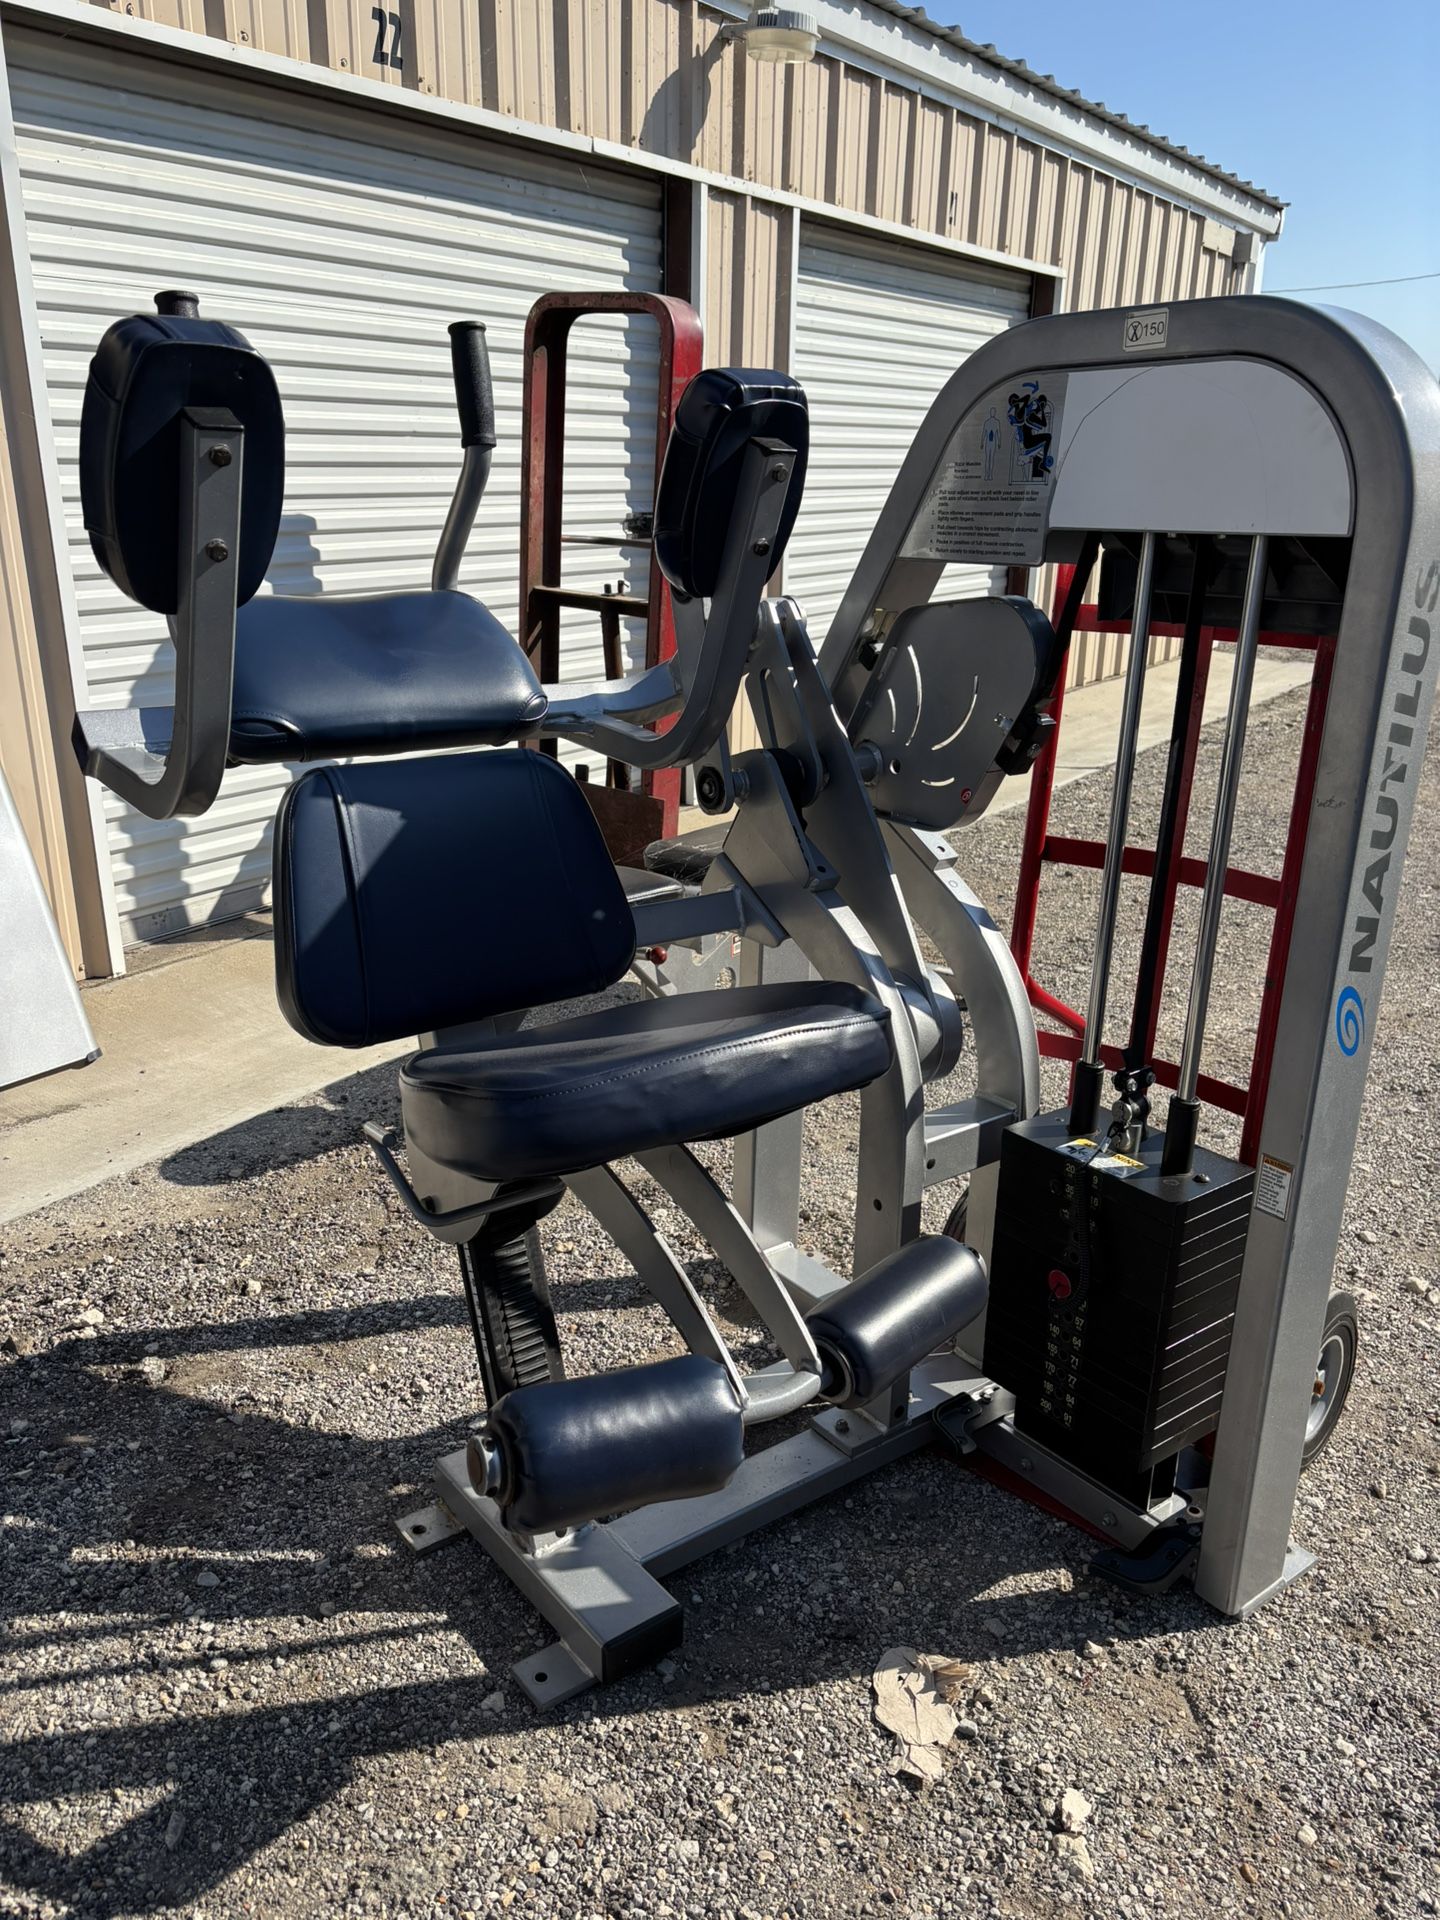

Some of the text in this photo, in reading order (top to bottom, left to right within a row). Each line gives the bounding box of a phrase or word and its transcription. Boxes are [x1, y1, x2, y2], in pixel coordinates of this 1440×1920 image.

[372, 6, 403, 70] 22
[1144, 321, 1165, 337] 150
[1348, 565, 1440, 973] NAUTILUS
[1070, 1354, 1079, 1366] 71
[1068, 1374, 1077, 1385] 77
